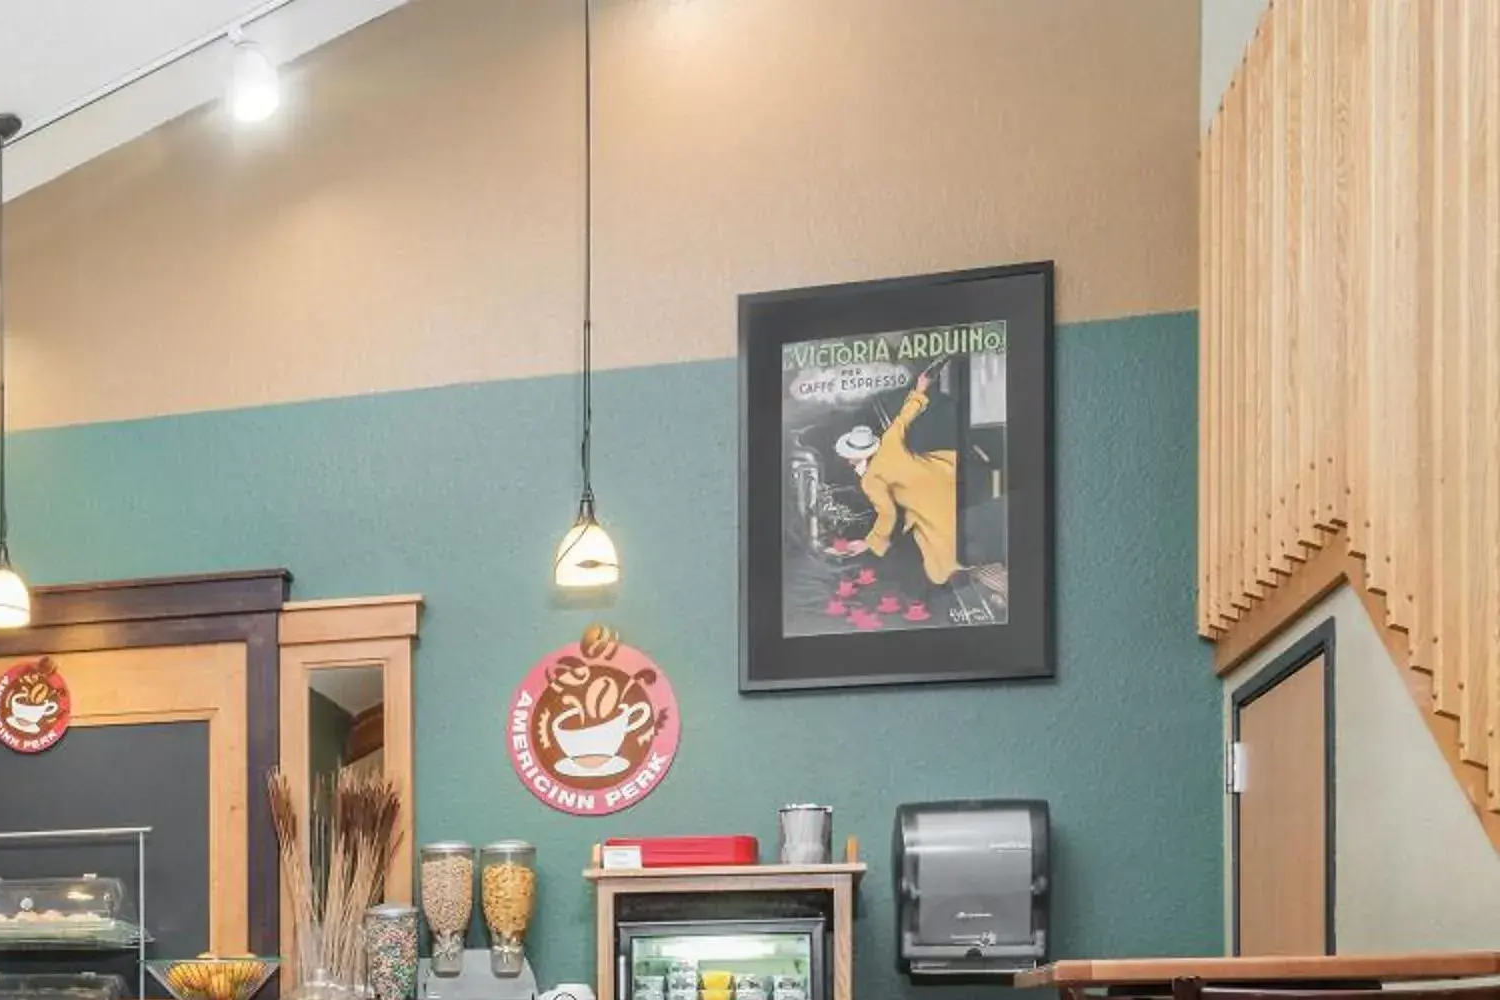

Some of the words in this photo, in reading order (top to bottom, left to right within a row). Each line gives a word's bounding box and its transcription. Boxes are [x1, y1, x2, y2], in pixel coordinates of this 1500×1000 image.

[795, 337, 890, 369] VICTORIA
[898, 327, 1001, 360] ARDUINO
[512, 689, 595, 810] AMERICINN
[604, 751, 668, 808] PERK
